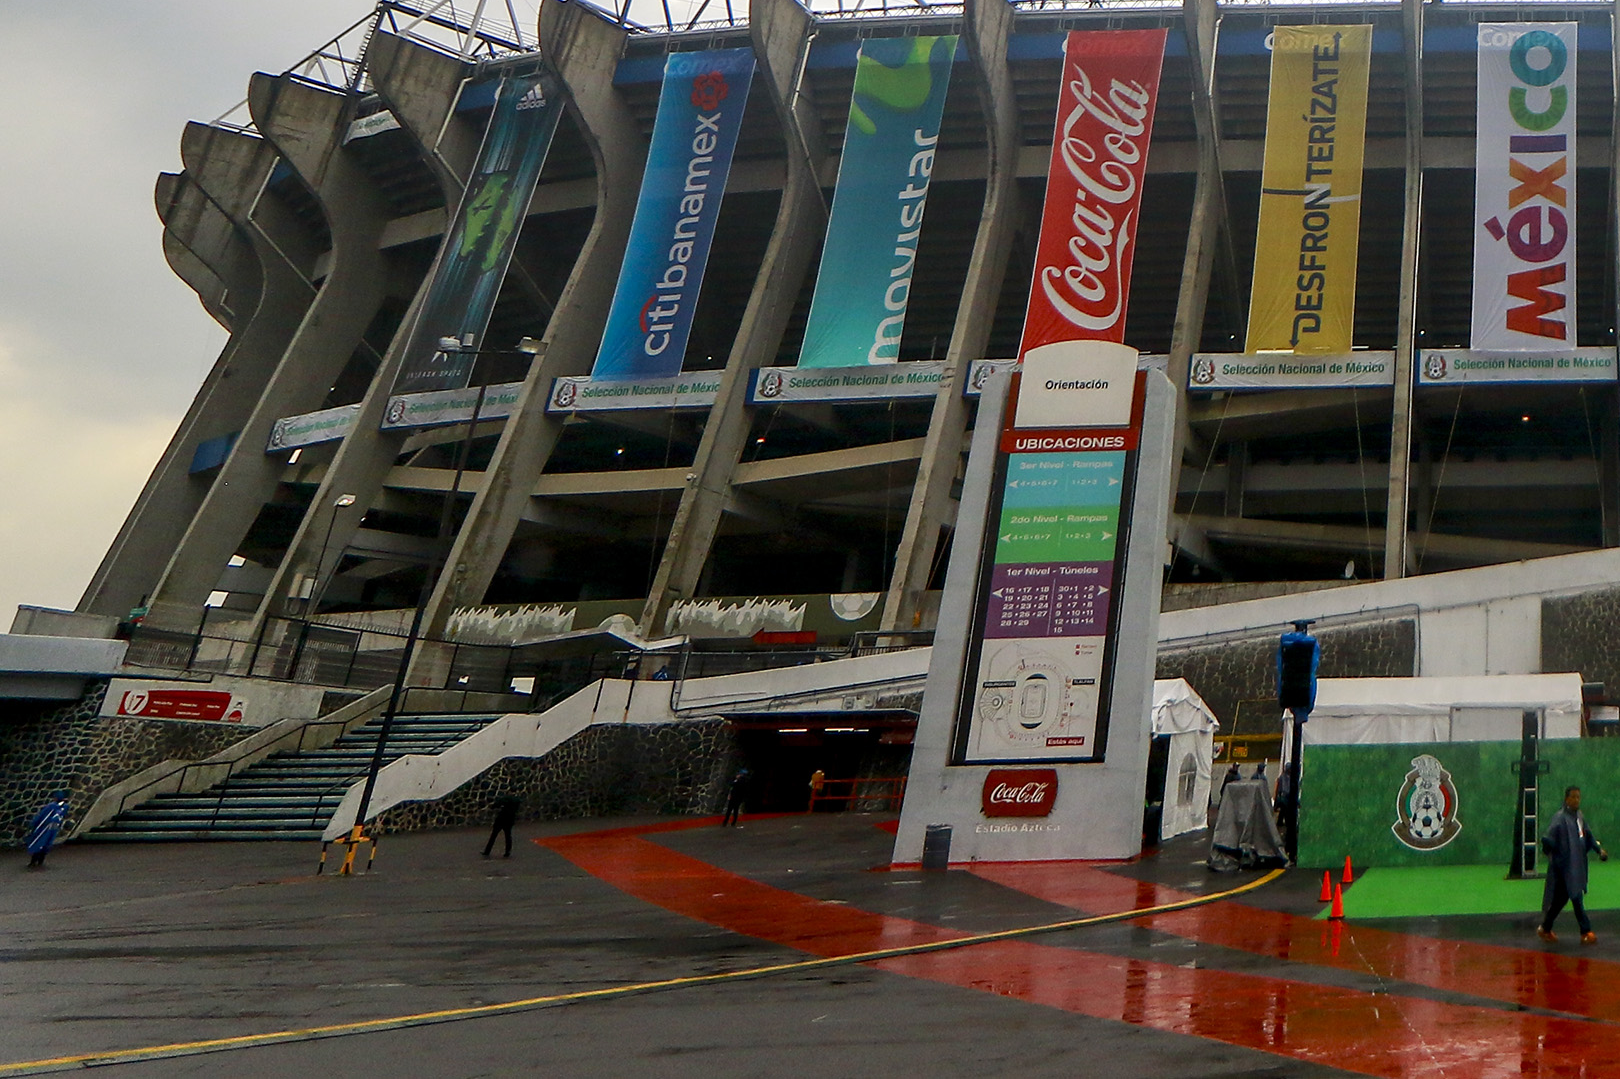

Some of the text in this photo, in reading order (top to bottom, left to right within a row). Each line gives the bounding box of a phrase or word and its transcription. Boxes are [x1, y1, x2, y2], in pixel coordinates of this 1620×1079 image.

[515, 98, 547, 111] adidas
[1042, 63, 1150, 331] Coca-Cola
[641, 112, 722, 357] citibanamex
[868, 129, 938, 365] movistar
[1223, 361, 1385, 375] Selección Nacional de México
[1454, 356, 1611, 370] Selección Nacional de México
[789, 375, 839, 388] Selección
[843, 374, 888, 386] Nacional
[891, 373, 904, 385] de
[1045, 379, 1109, 390] Orientación
[582, 381, 720, 398] Selección Nacional de Méxic
[1015, 436, 1125, 450] UBICACIONES
[1007, 568, 1022, 576] 1er
[1024, 567, 1051, 575] Nivel
[1060, 566, 1099, 575] Túneles
[990, 782, 1049, 804] Coca-Cola
[975, 823, 1018, 833] Estadio
